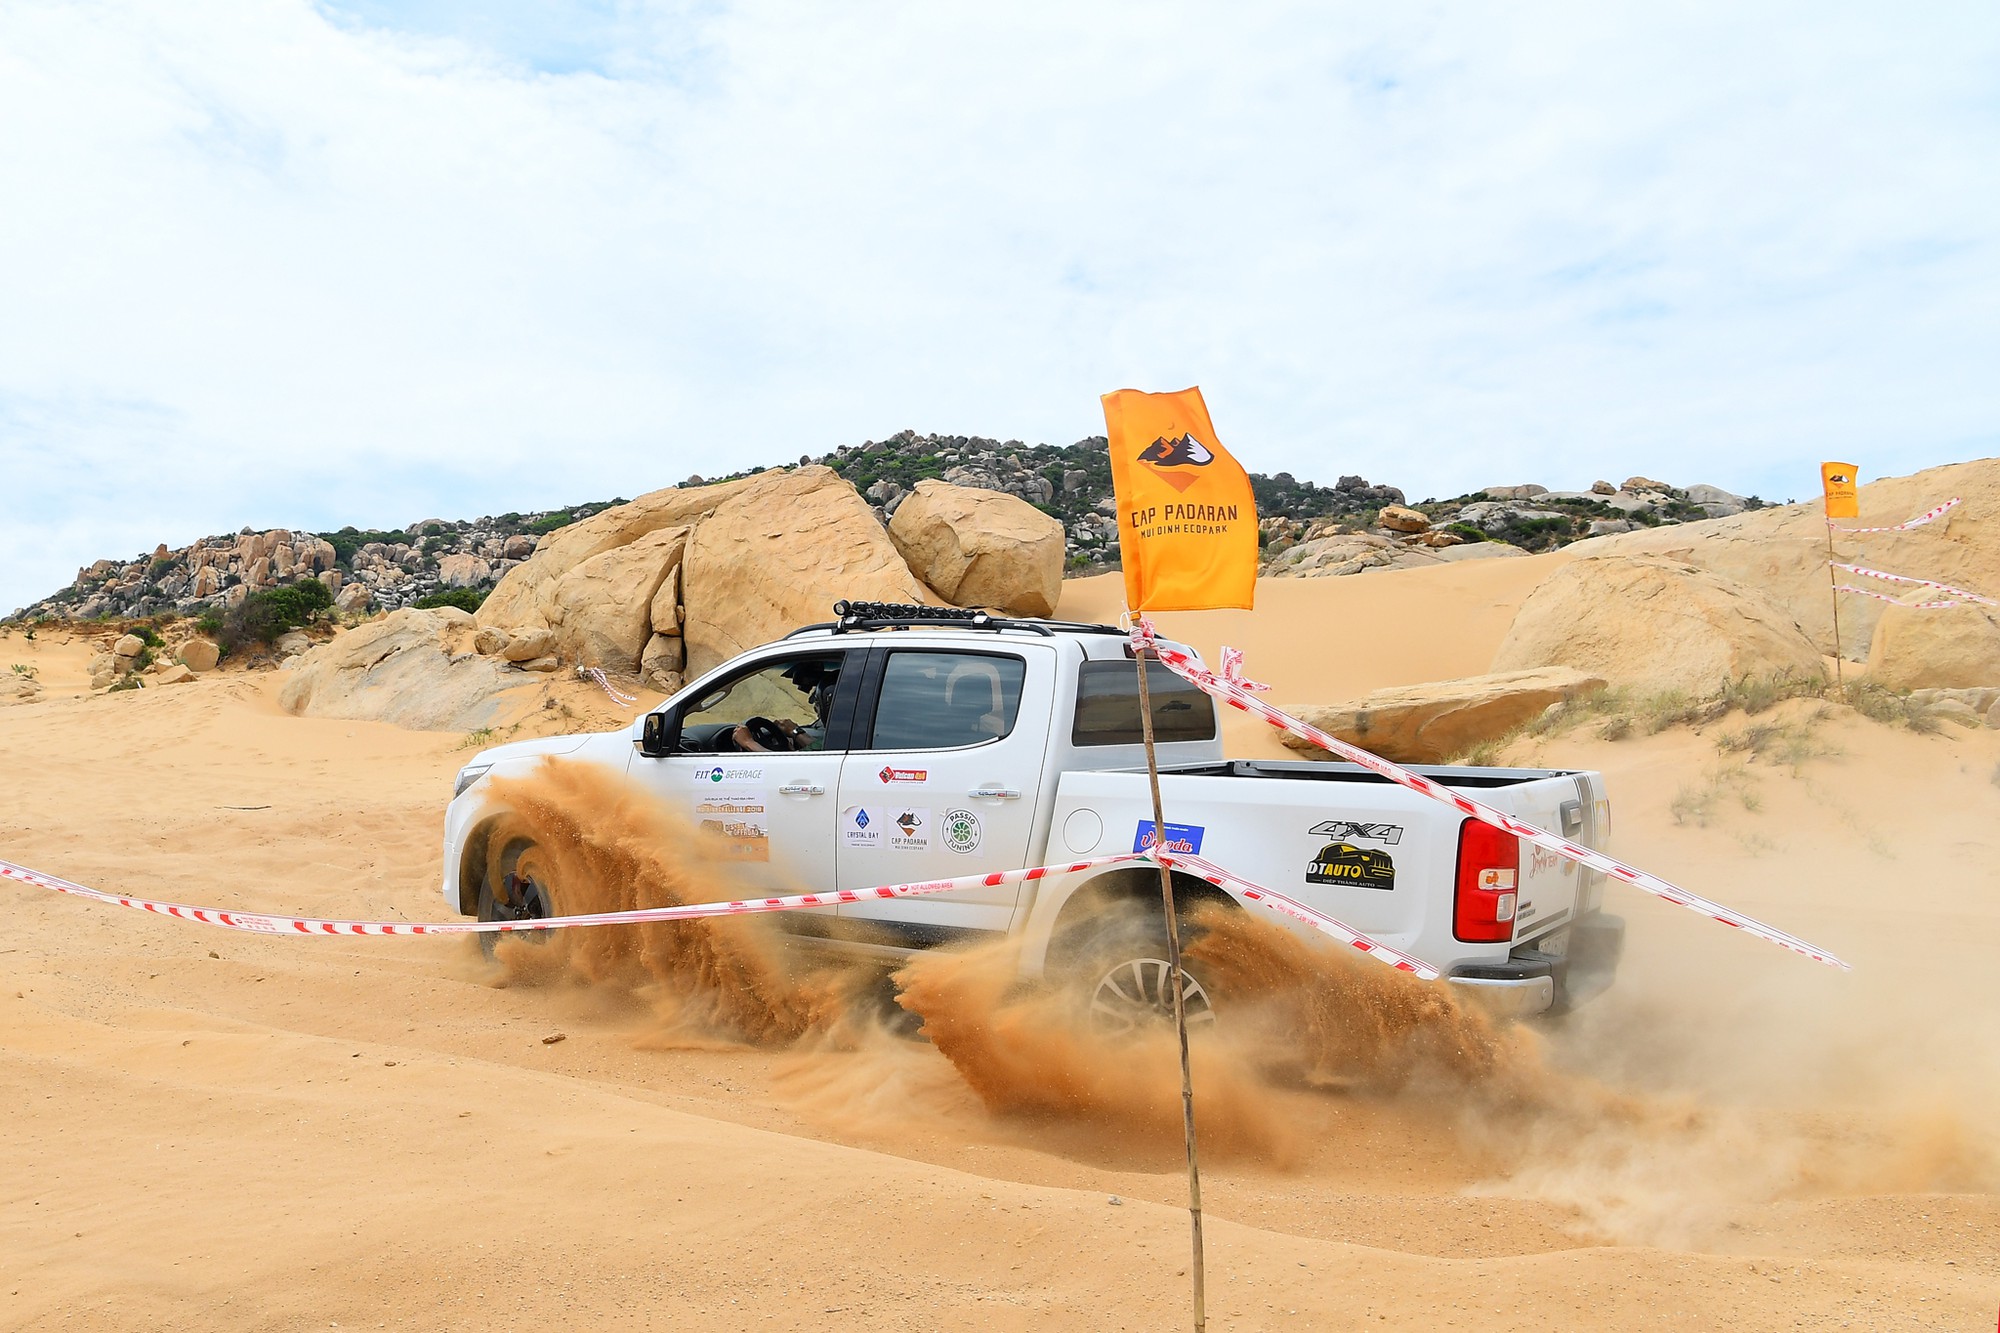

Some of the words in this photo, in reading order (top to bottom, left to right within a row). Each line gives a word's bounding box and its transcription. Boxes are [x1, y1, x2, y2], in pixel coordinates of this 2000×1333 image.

[1131, 507, 1156, 528] CAP
[1165, 503, 1237, 521] PADARAN
[1141, 527, 1154, 539] MUI
[1157, 524, 1180, 535] DINH
[1183, 524, 1227, 534] ECOPARK
[726, 769, 763, 779] BEVERAGE
[949, 812, 976, 825] PASSIO
[847, 831, 867, 839] CRYSTAL
[891, 837, 901, 845] CAP
[903, 838, 928, 846] PADARAN
[948, 838, 975, 851] TUNING
